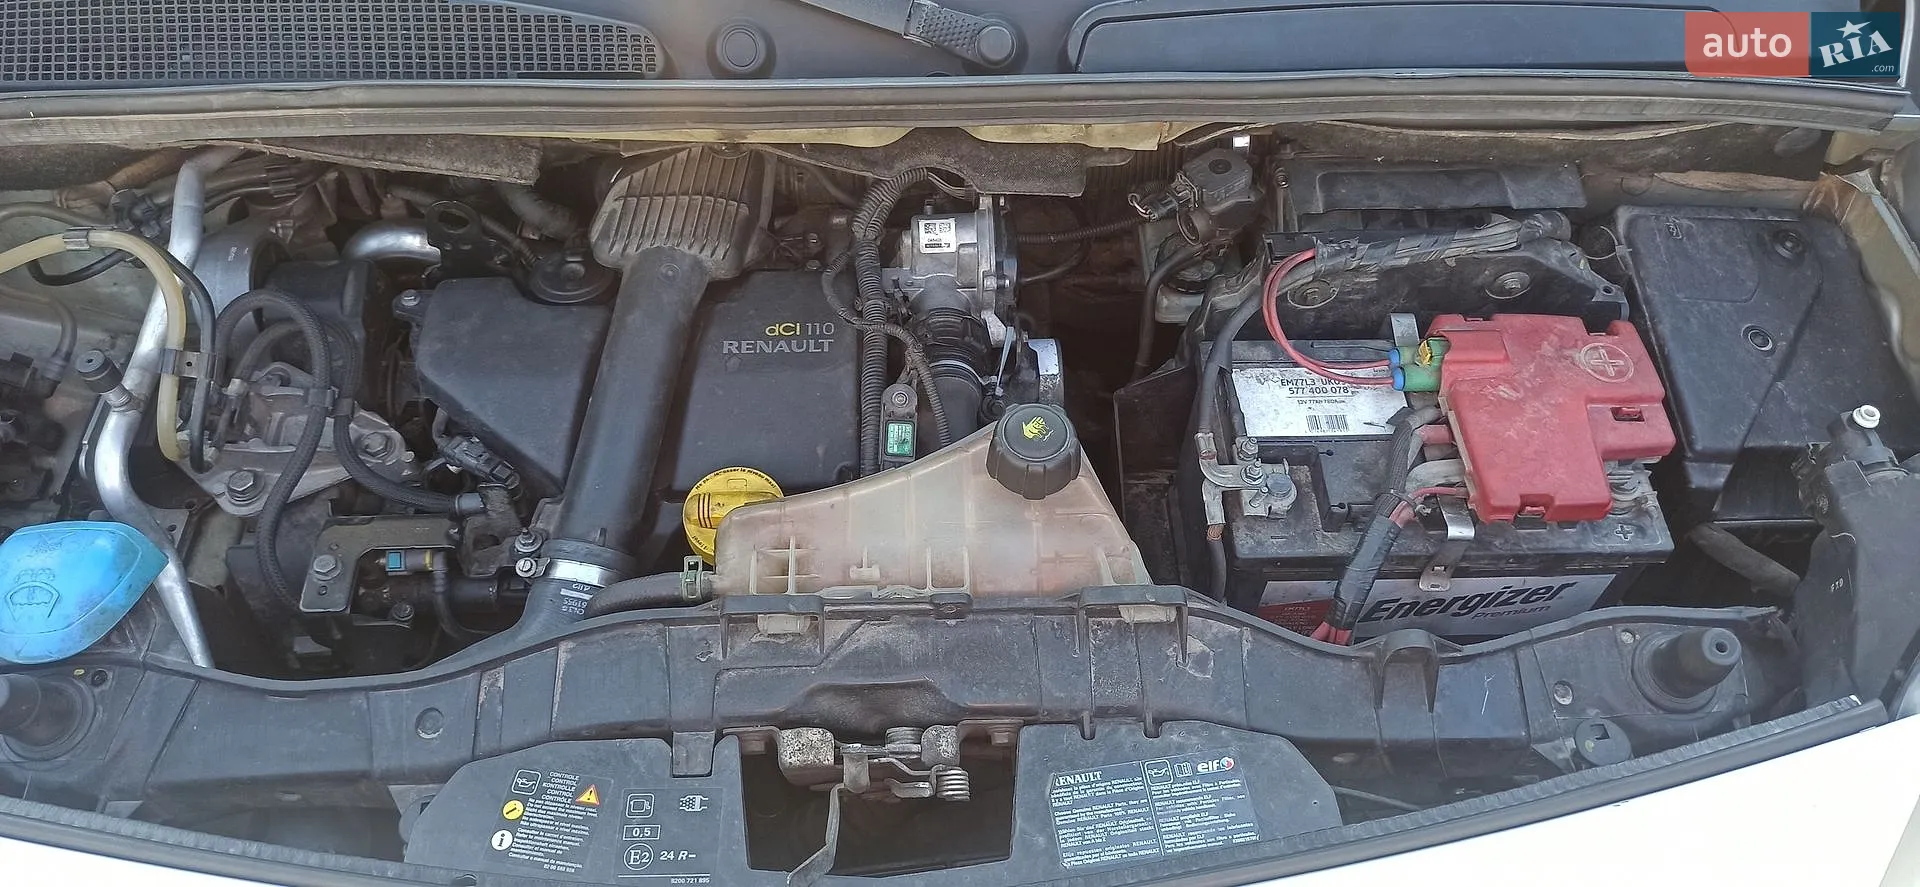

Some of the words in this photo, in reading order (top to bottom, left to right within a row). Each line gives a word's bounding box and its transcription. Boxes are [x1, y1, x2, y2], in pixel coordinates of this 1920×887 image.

[806, 322, 834, 335] 110
[722, 340, 834, 354] RENAULT
[1330, 386, 1349, 394] 078
[1357, 582, 1578, 622] Energizer
[1472, 605, 1550, 620] premium
[1197, 760, 1220, 772] elf
[632, 828, 651, 838] 0,5
[660, 850, 674, 860] 24
